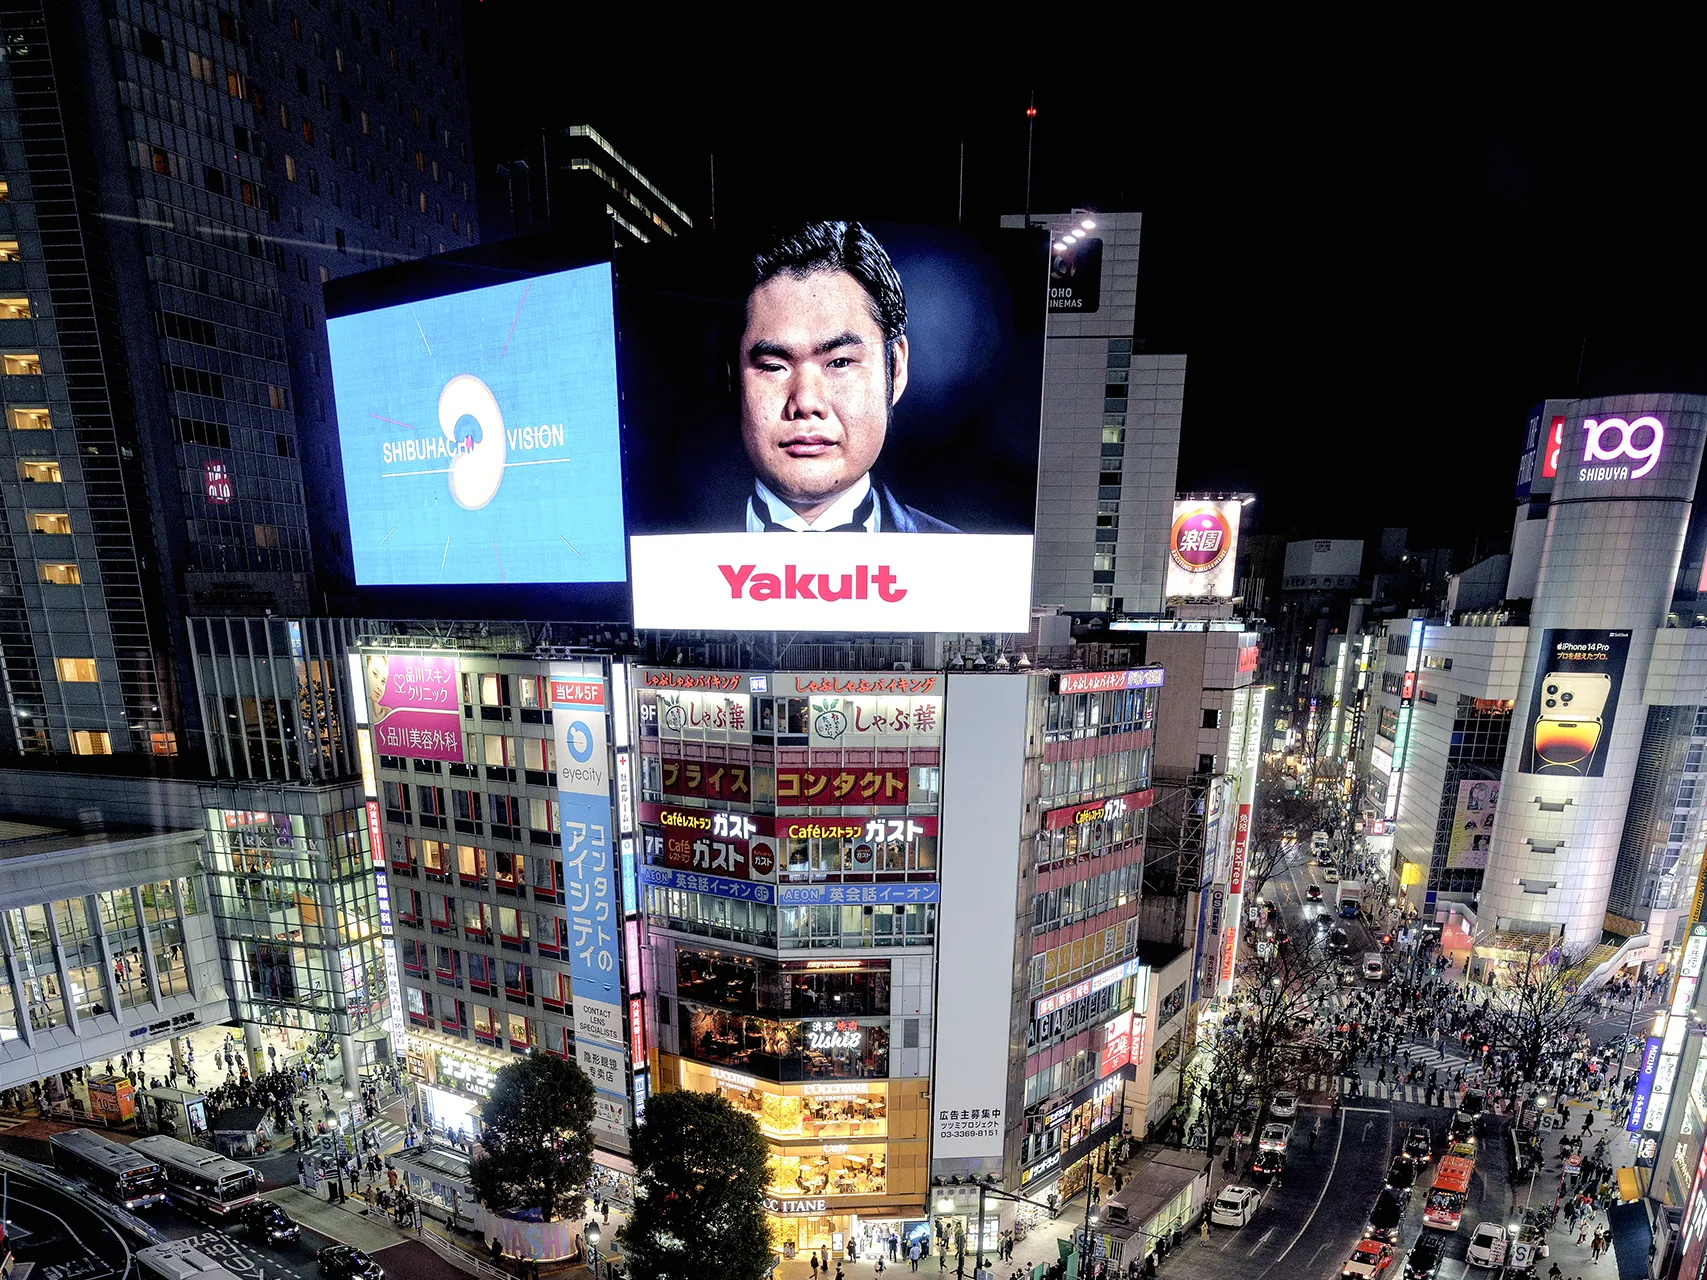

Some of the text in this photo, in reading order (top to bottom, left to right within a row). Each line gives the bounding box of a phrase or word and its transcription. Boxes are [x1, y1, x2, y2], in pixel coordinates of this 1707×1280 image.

[1048, 287, 1072, 298] OHO
[1049, 299, 1083, 308] INEMAS
[507, 424, 565, 450] VISION
[1582, 416, 1665, 479] 109
[1579, 467, 1628, 482] SHIBUYA
[1180, 530, 1222, 551] 楽園
[1193, 549, 1227, 572] AMUSEMENT
[717, 563, 908, 603] Yakult
[1562, 643, 1610, 651] iPhone 14 Pro
[405, 666, 452, 684] 品川スキン
[643, 671, 741, 691] しゃぶしゃぶバイキング
[407, 685, 448, 703] クリニック
[556, 684, 599, 701] 当ビル5F
[795, 676, 937, 694] しゃぶしゃぶバイキング
[641, 704, 656, 721] 9F
[690, 701, 745, 730] しゃぶ葉
[855, 704, 937, 732] しゃぶ葉
[387, 726, 458, 752] 品川美容外科
[562, 767, 602, 786] eyecity
[663, 763, 749, 793] プライス
[777, 773, 905, 799] コンタクト
[713, 813, 756, 840] ガスト
[866, 819, 924, 842] ガスト
[668, 839, 691, 853] Café
[693, 839, 745, 871] ガスト
[754, 857, 773, 867] ガスト
[643, 869, 670, 885] AEON
[675, 873, 751, 897] 英会話イーオン
[566, 821, 595, 968] アイシティ
[590, 824, 613, 973] コンタクトの
[784, 887, 937, 903] AEON 英会話イーオン
[583, 1005, 611, 1019] CONTACT
[589, 1016, 606, 1027] LENS
[811, 1021, 834, 1032] 渋谷
[579, 1023, 618, 1039] SPECIALISTS
[1093, 1072, 1121, 1105] LUSH
[939, 1109, 1001, 1120] 広告主募集中
[940, 1121, 999, 1130] ツツミプロジェクト
[940, 1130, 998, 1138] 03-3369-8151
